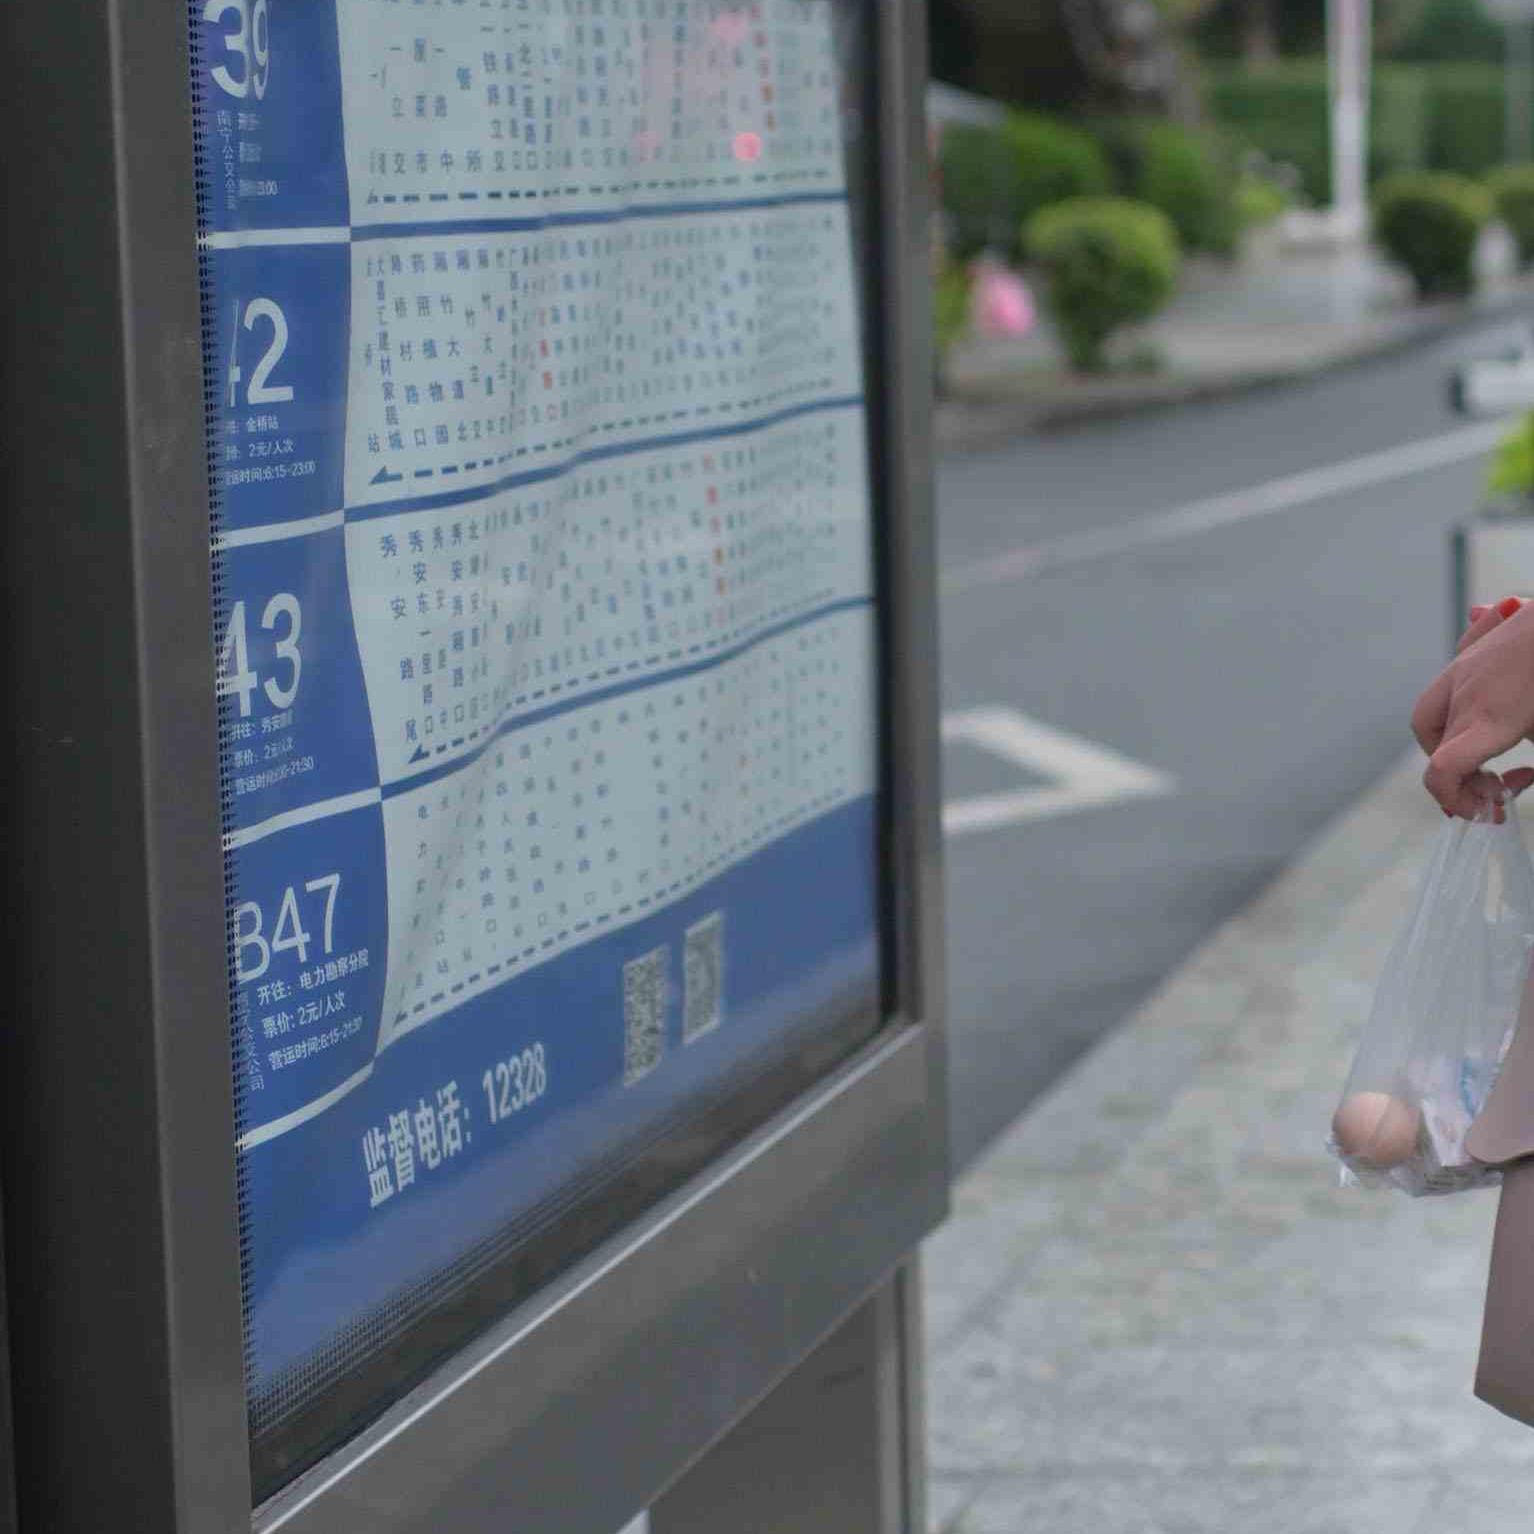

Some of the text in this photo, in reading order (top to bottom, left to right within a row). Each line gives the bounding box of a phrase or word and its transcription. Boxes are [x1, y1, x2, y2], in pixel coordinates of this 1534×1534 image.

[216, 592, 301, 718] 43
[232, 872, 341, 983] B47
[256, 978, 293, 1006] 开往:
[262, 990, 346, 1039] 票价: 2元/人次
[362, 1040, 547, 1208] 监督电话: 12328
